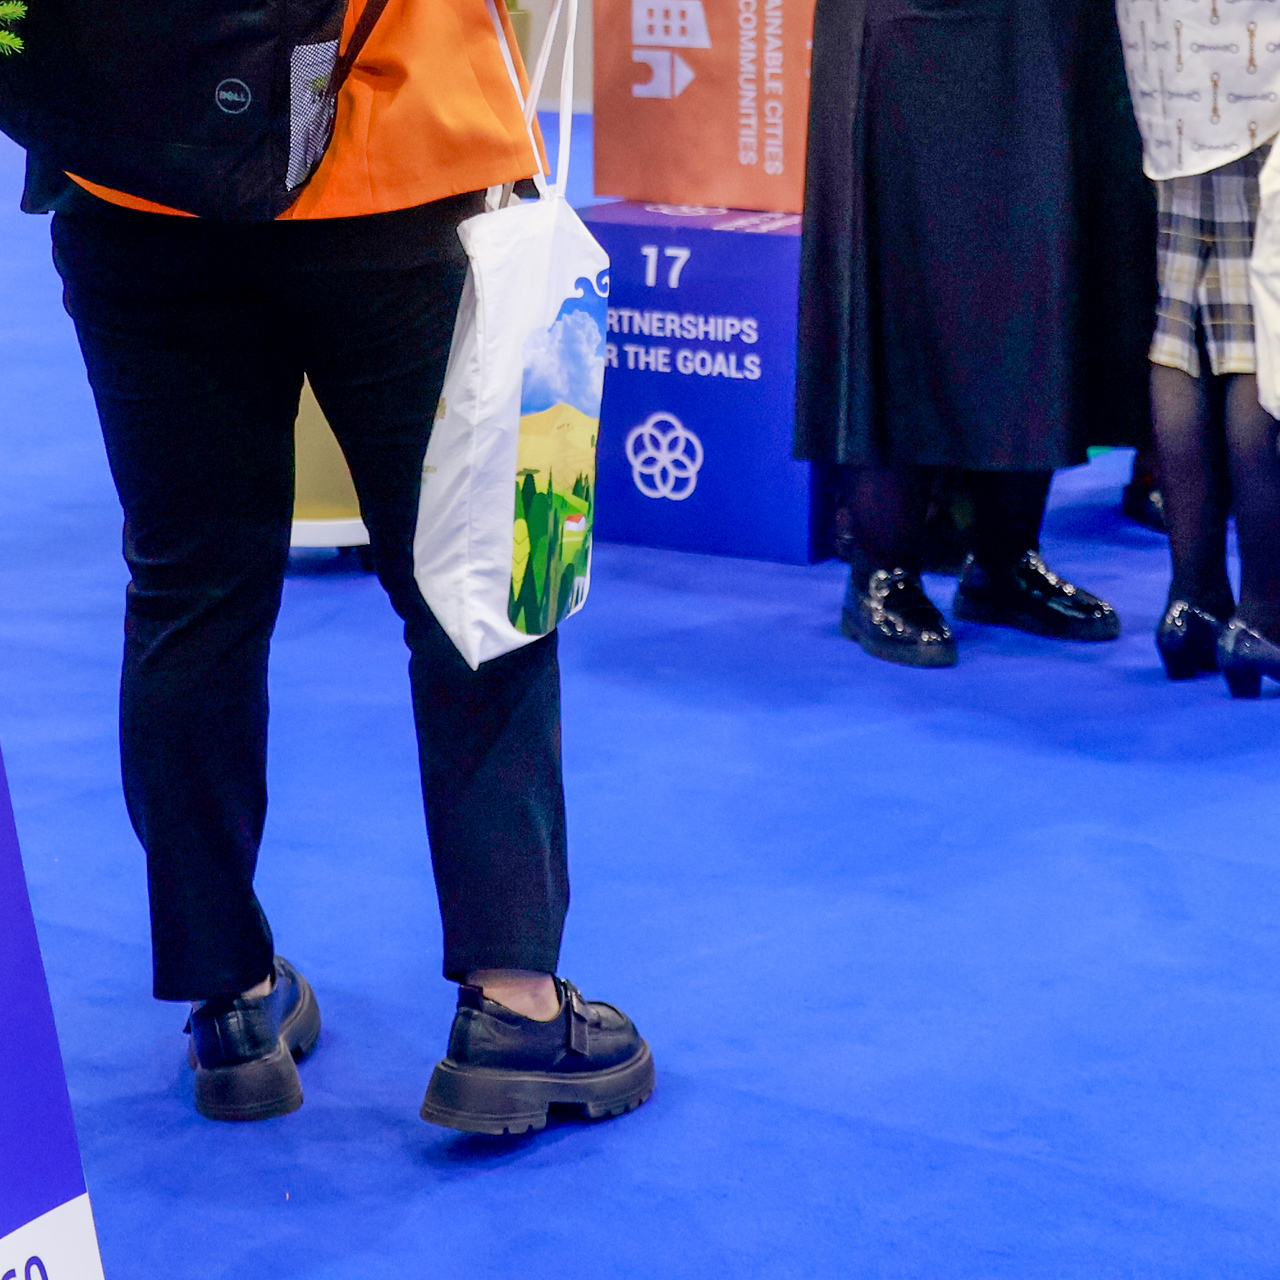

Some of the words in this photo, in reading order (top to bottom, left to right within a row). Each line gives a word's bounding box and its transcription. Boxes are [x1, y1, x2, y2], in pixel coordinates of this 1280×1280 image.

[764, 99, 784, 175] CITIES
[640, 244, 692, 290] 17
[606, 306, 759, 345] RTNERSHIPS
[622, 342, 672, 373] THE
[675, 348, 763, 381] GOALS
